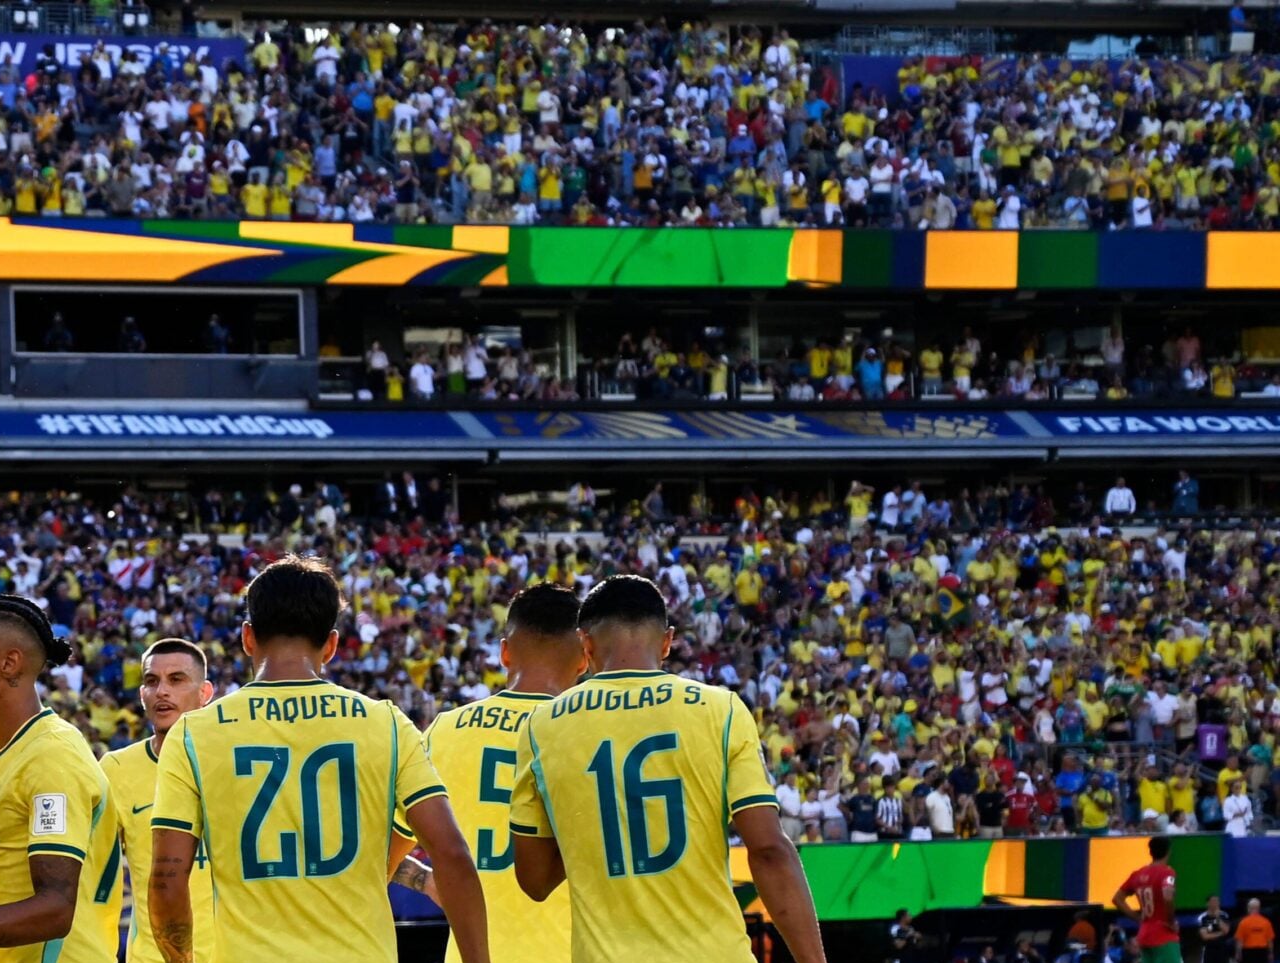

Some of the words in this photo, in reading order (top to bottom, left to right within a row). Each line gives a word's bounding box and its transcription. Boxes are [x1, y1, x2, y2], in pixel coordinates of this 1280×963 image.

[36, 414, 334, 438] #FIFAWorldCup
[1057, 416, 1158, 433] FIFA
[1153, 415, 1280, 433] WORL
[217, 704, 238, 723] L.
[551, 683, 673, 719] DOUGLAS
[684, 686, 706, 705] S.
[456, 706, 530, 732] CASE
[233, 742, 359, 880] 20
[477, 746, 517, 872] 5
[587, 731, 688, 878] 16
